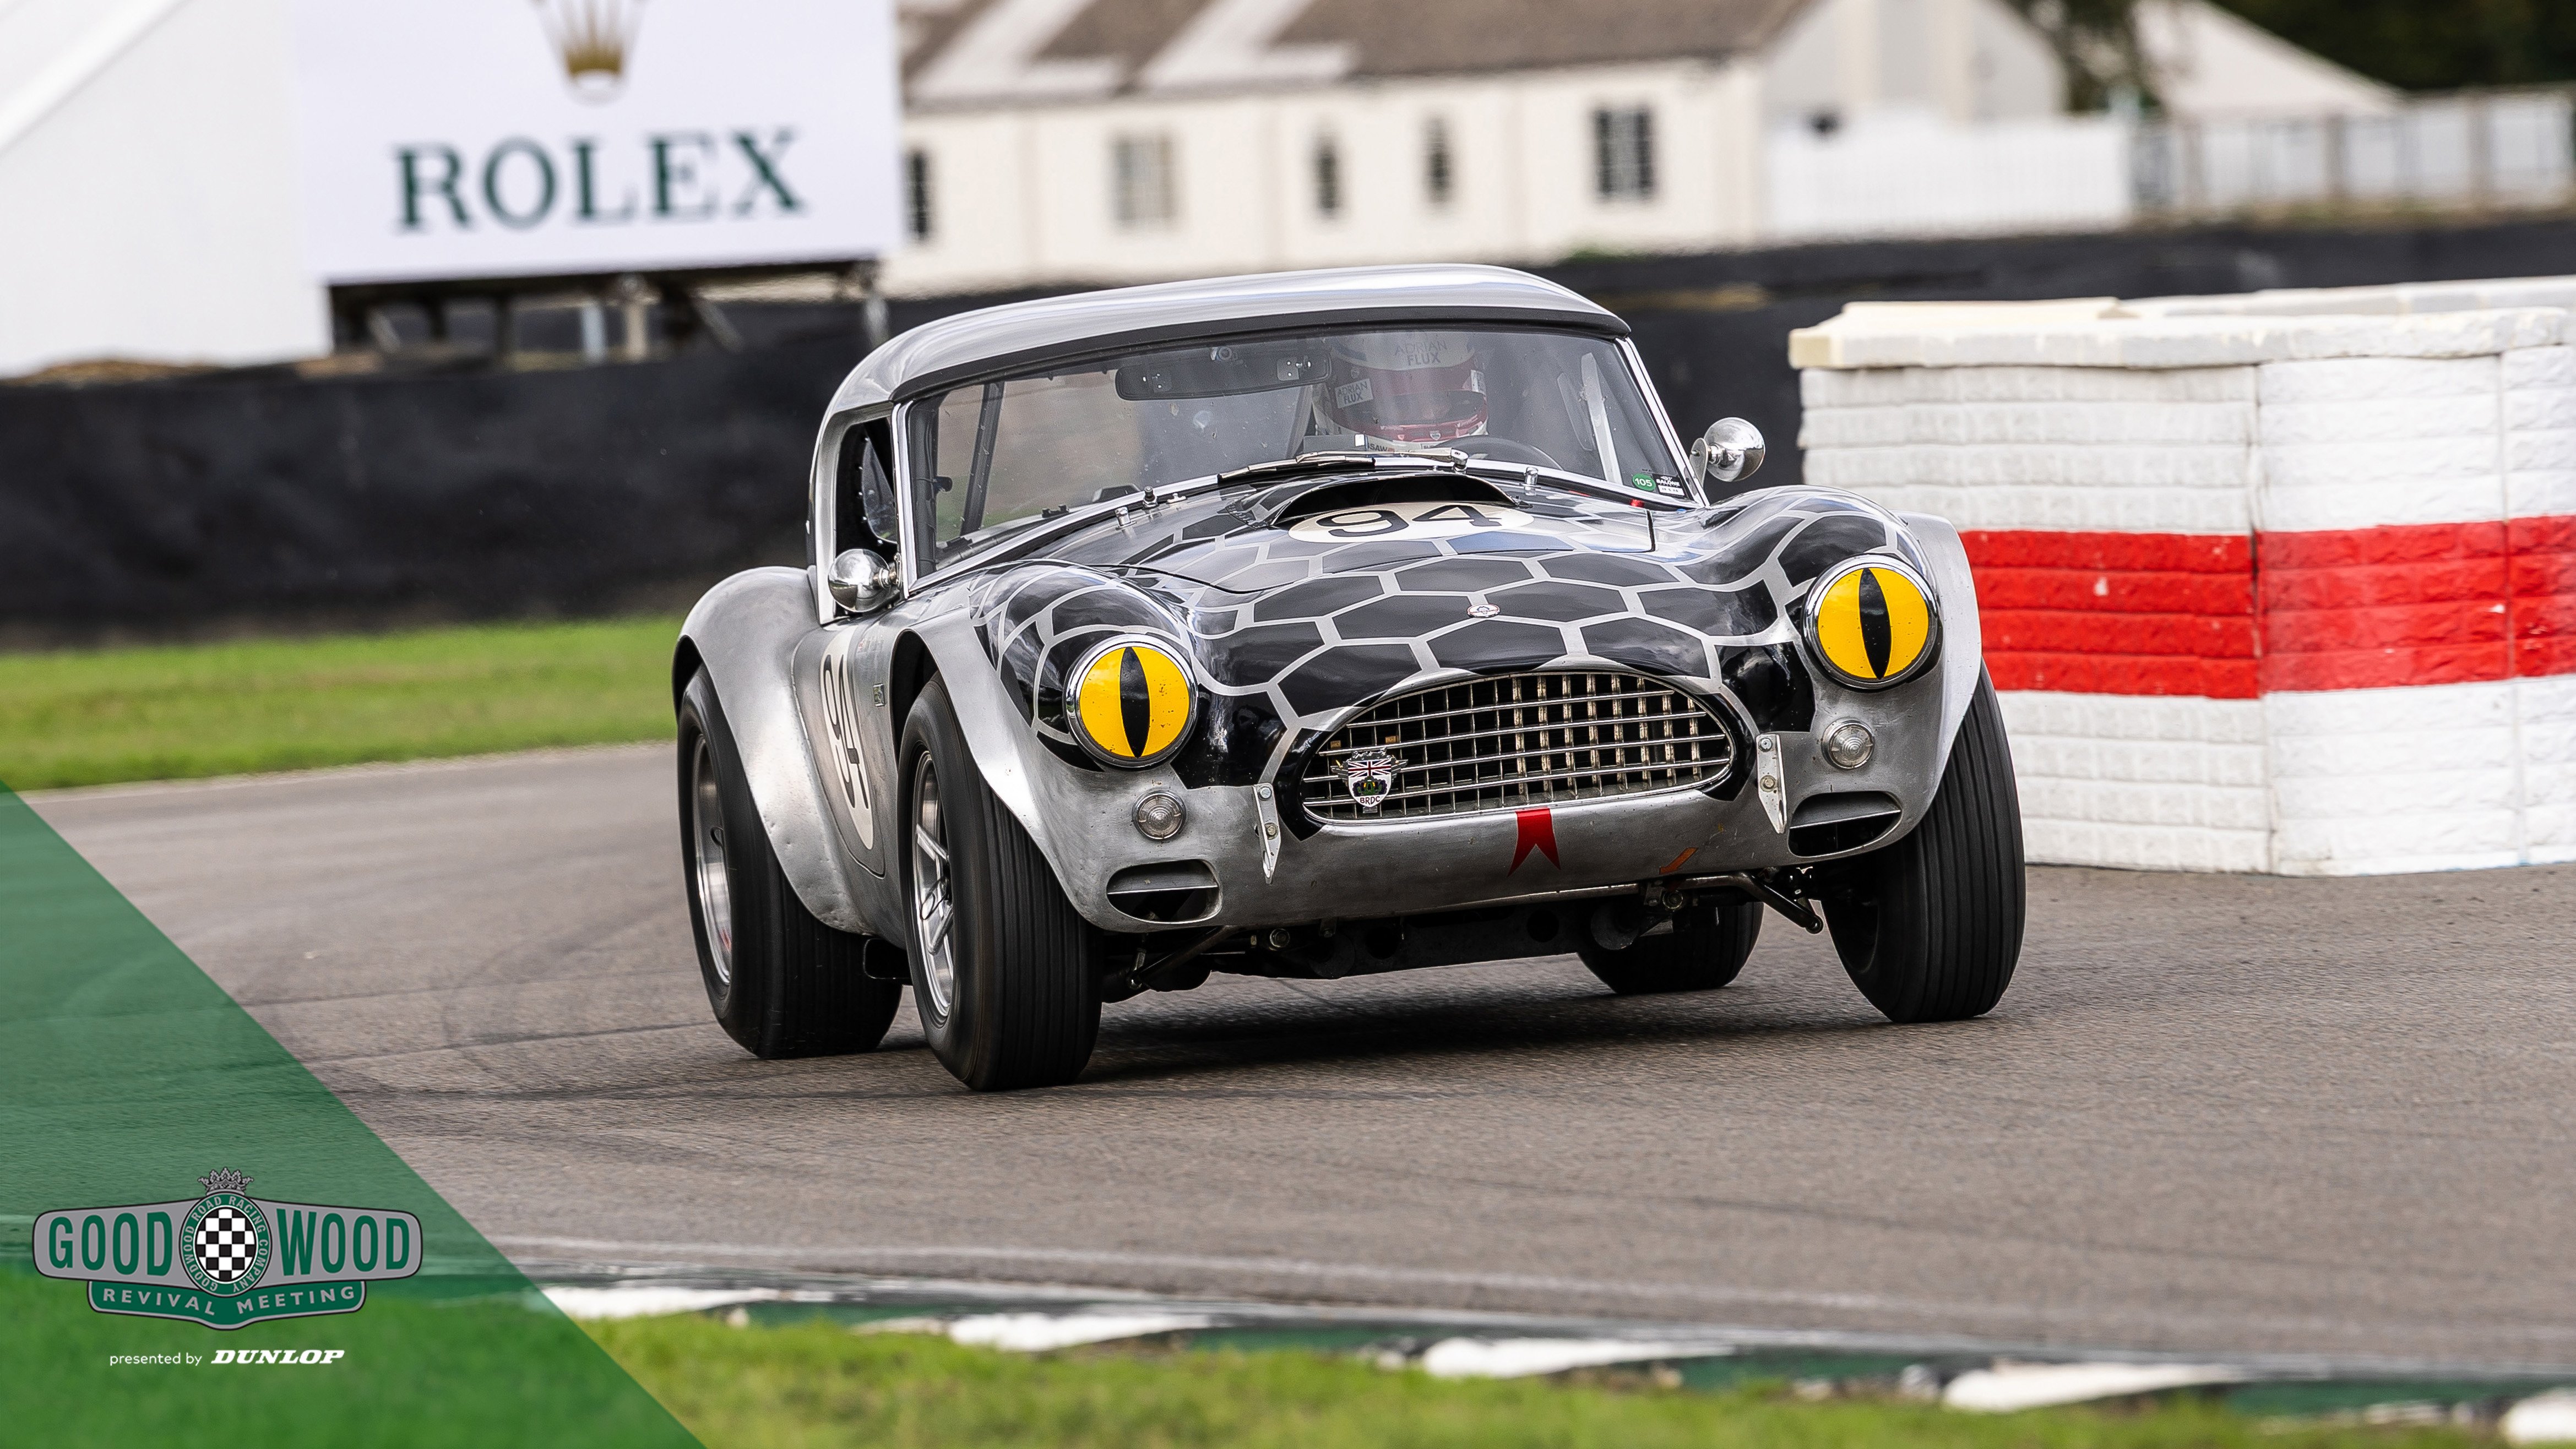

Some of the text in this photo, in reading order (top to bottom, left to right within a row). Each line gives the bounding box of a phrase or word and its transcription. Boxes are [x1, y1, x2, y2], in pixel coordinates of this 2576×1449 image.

[392, 126, 805, 233] ROLEX
[1395, 340, 1448, 356] ADRIAN
[1407, 353, 1441, 366] FLUX
[1337, 381, 1368, 396] ADRIAN
[1344, 392, 1363, 405] FLUX
[1634, 477, 1653, 487] 105
[1316, 505, 1503, 537] 94
[823, 654, 869, 809] 94
[1360, 796, 1381, 805] BRDC
